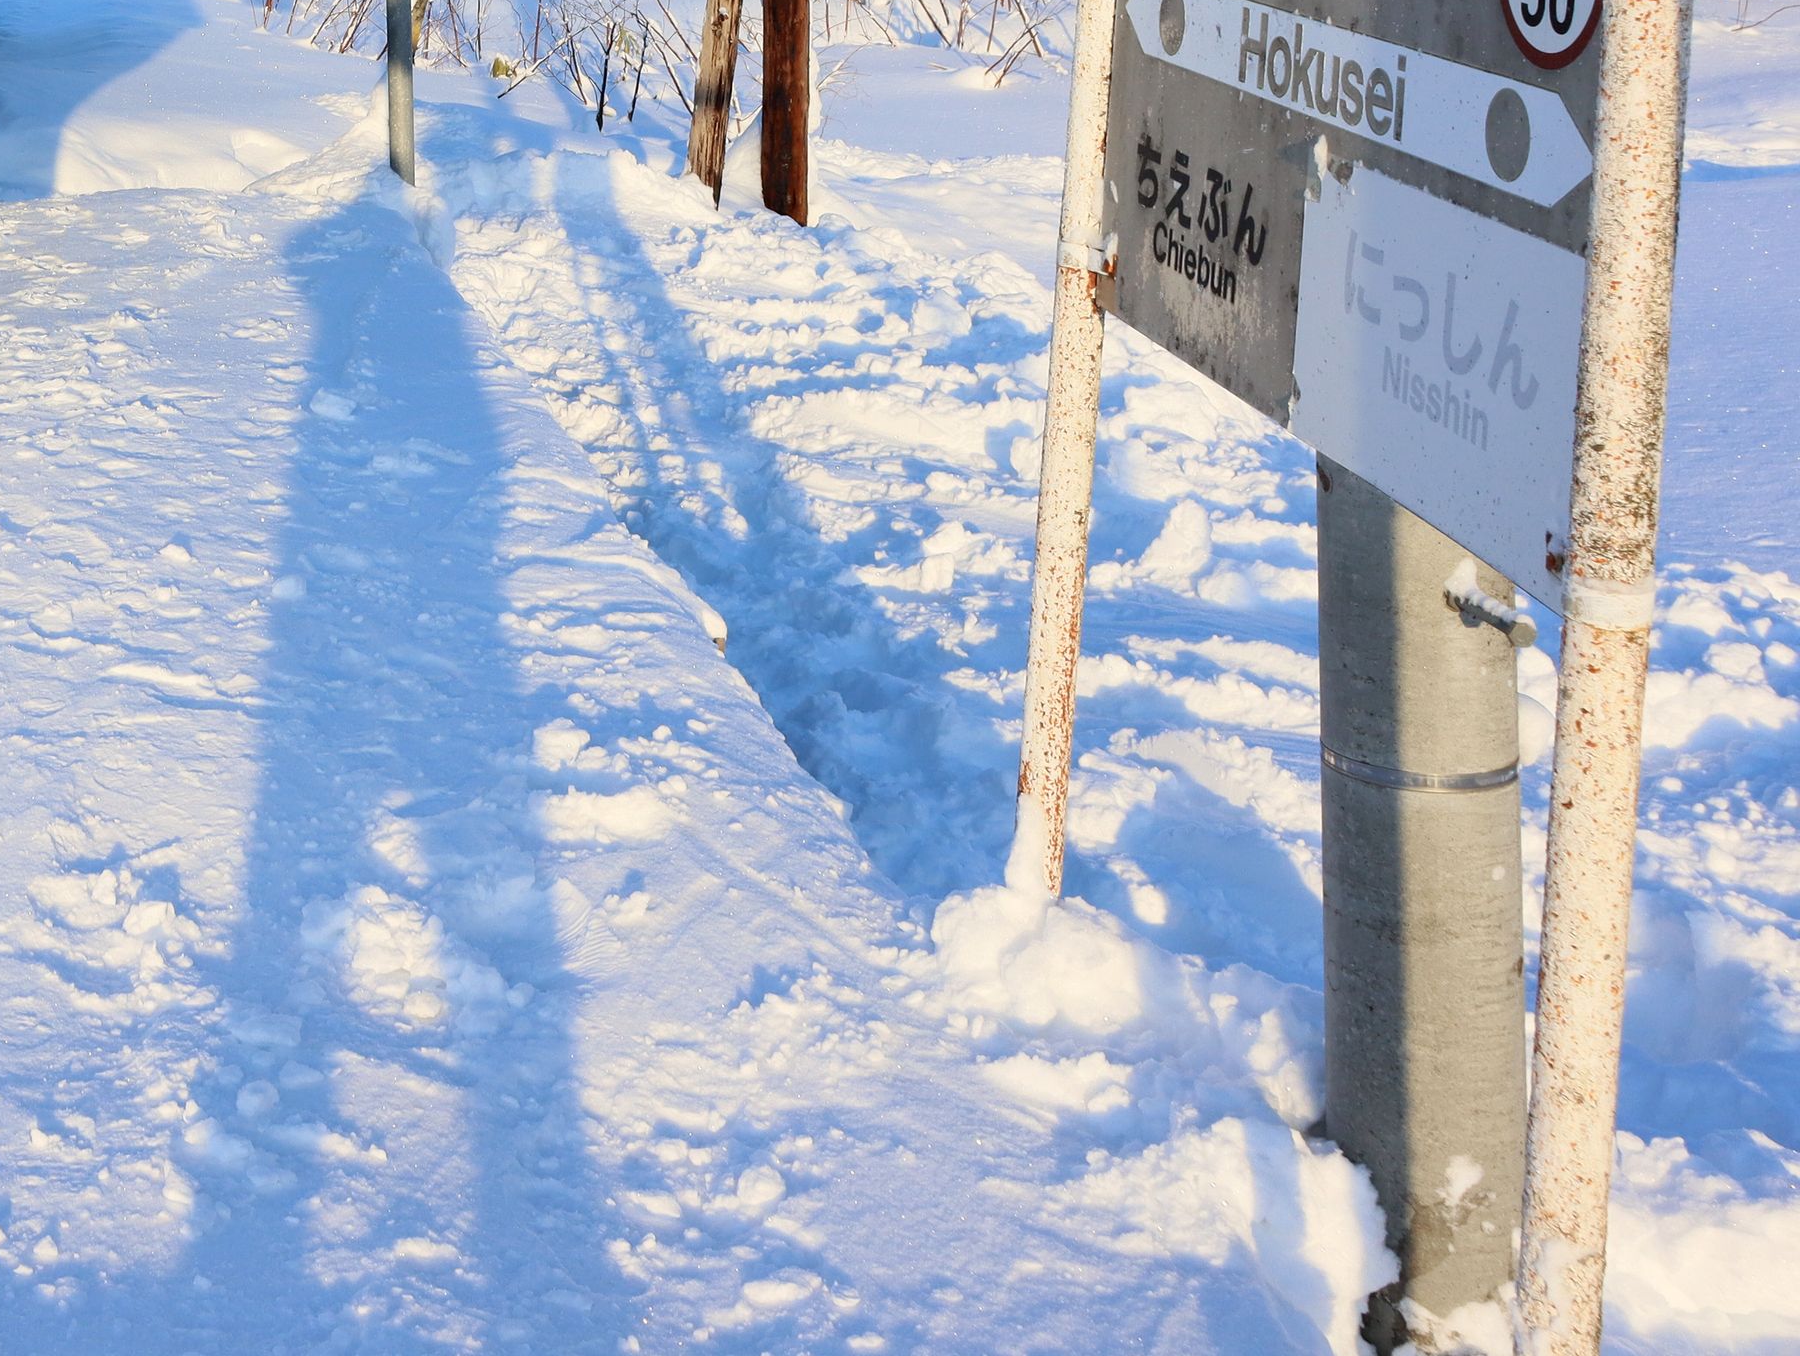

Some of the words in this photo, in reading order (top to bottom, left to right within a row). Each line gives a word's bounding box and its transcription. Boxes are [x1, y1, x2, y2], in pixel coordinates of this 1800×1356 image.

[1237, 6, 1407, 142] Hokusei
[1137, 134, 1267, 266] ちえぶん
[1152, 221, 1237, 304] Chiebun
[1381, 345, 1489, 452] Nisshin
